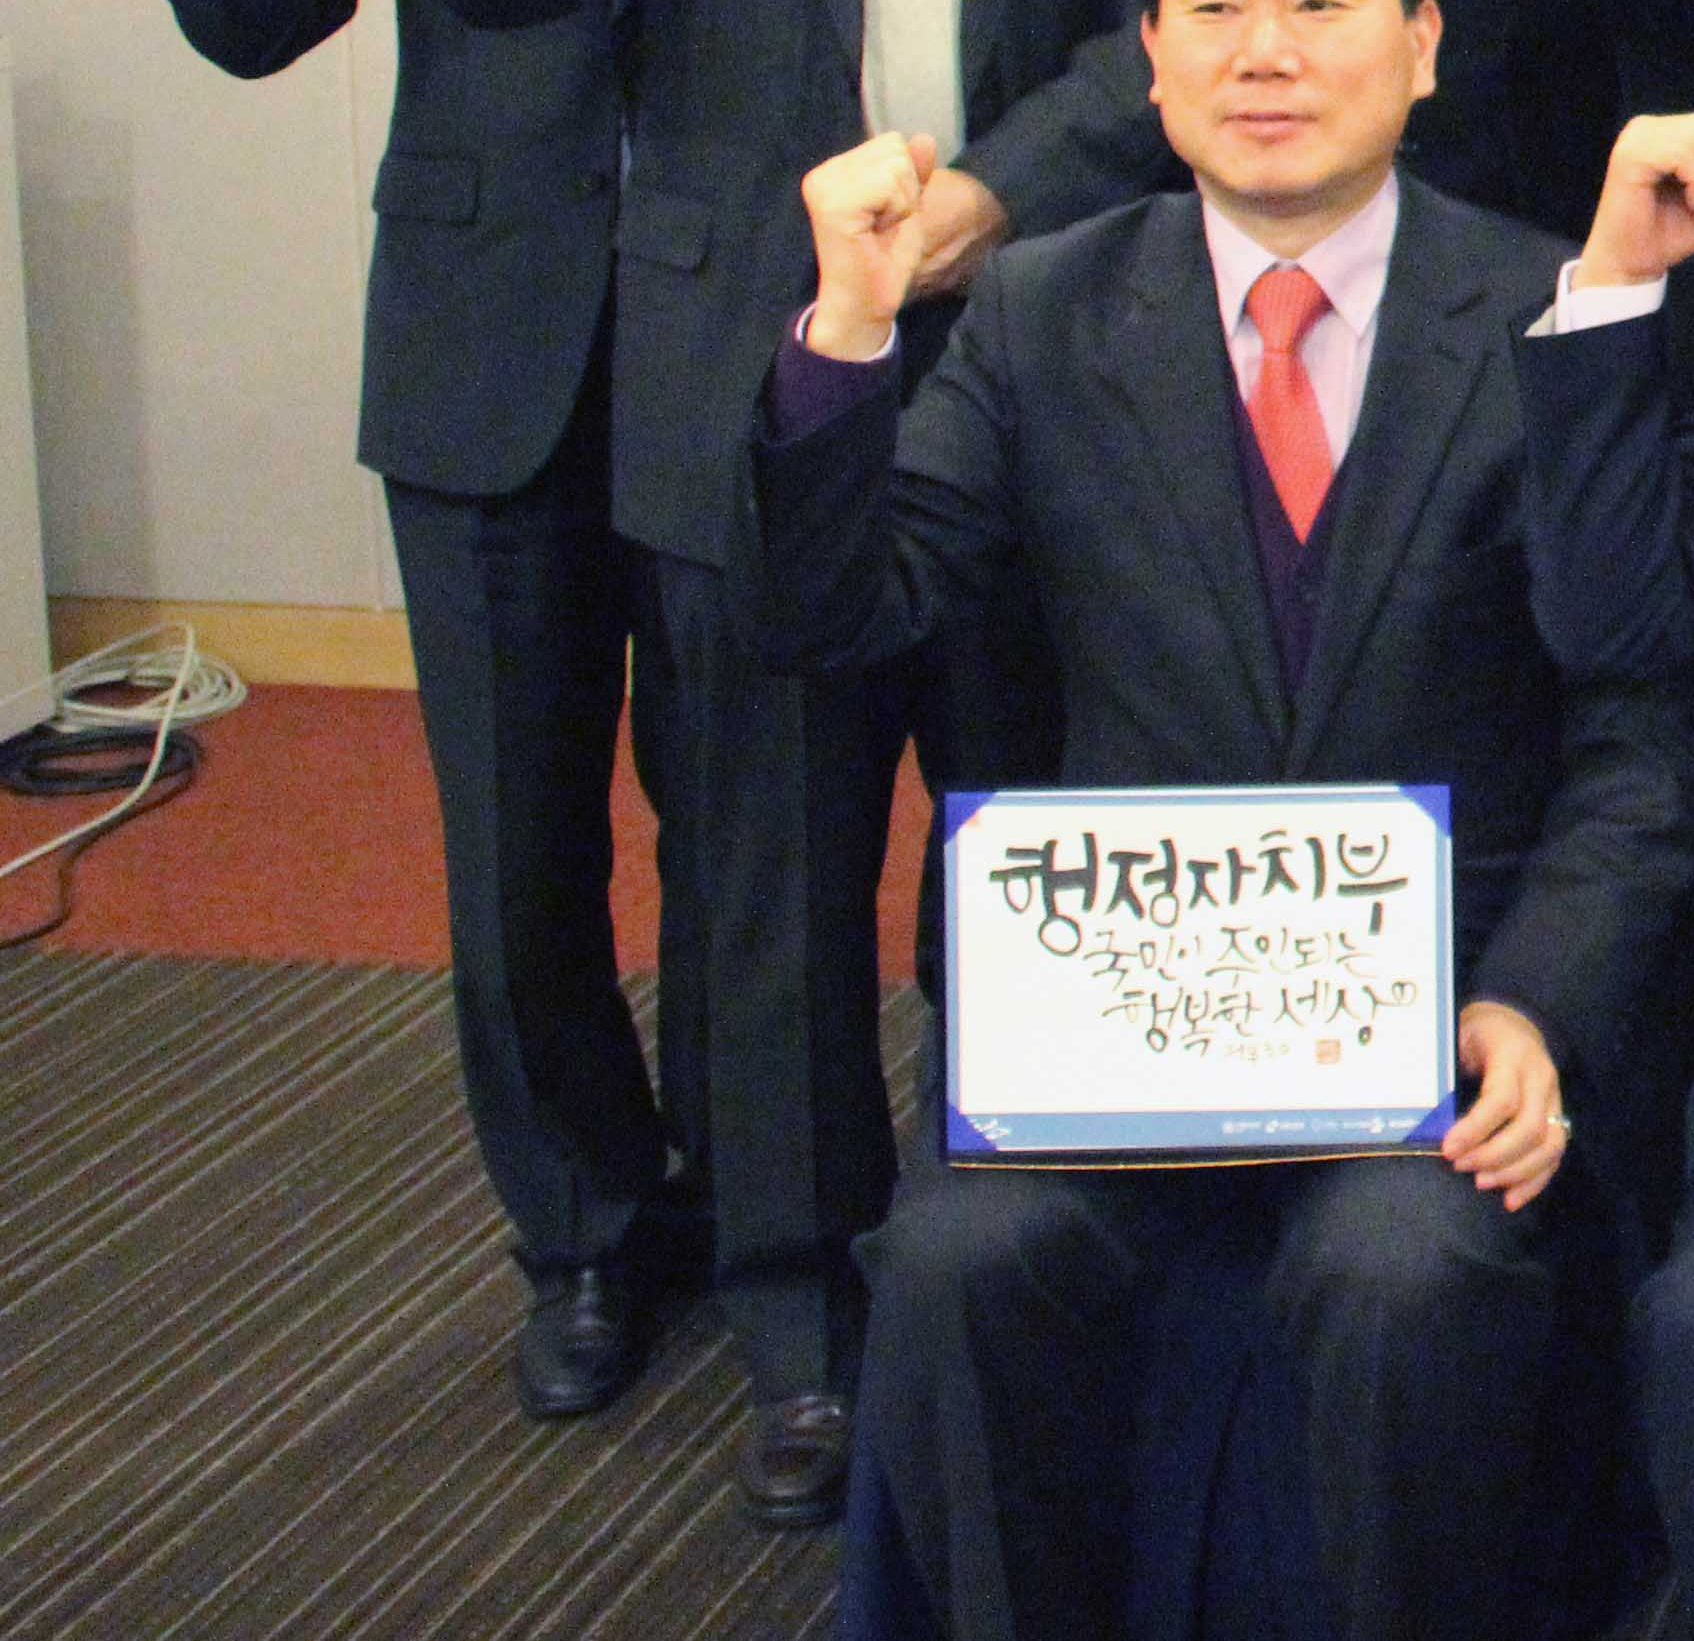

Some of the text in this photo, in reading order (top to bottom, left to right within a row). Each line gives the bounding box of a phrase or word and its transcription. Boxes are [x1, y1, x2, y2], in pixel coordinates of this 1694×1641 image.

[989, 829, 1409, 957] 행정자치부
[1083, 928, 1201, 990] 국민이
[1101, 978, 1384, 1054] 행복한 세상
